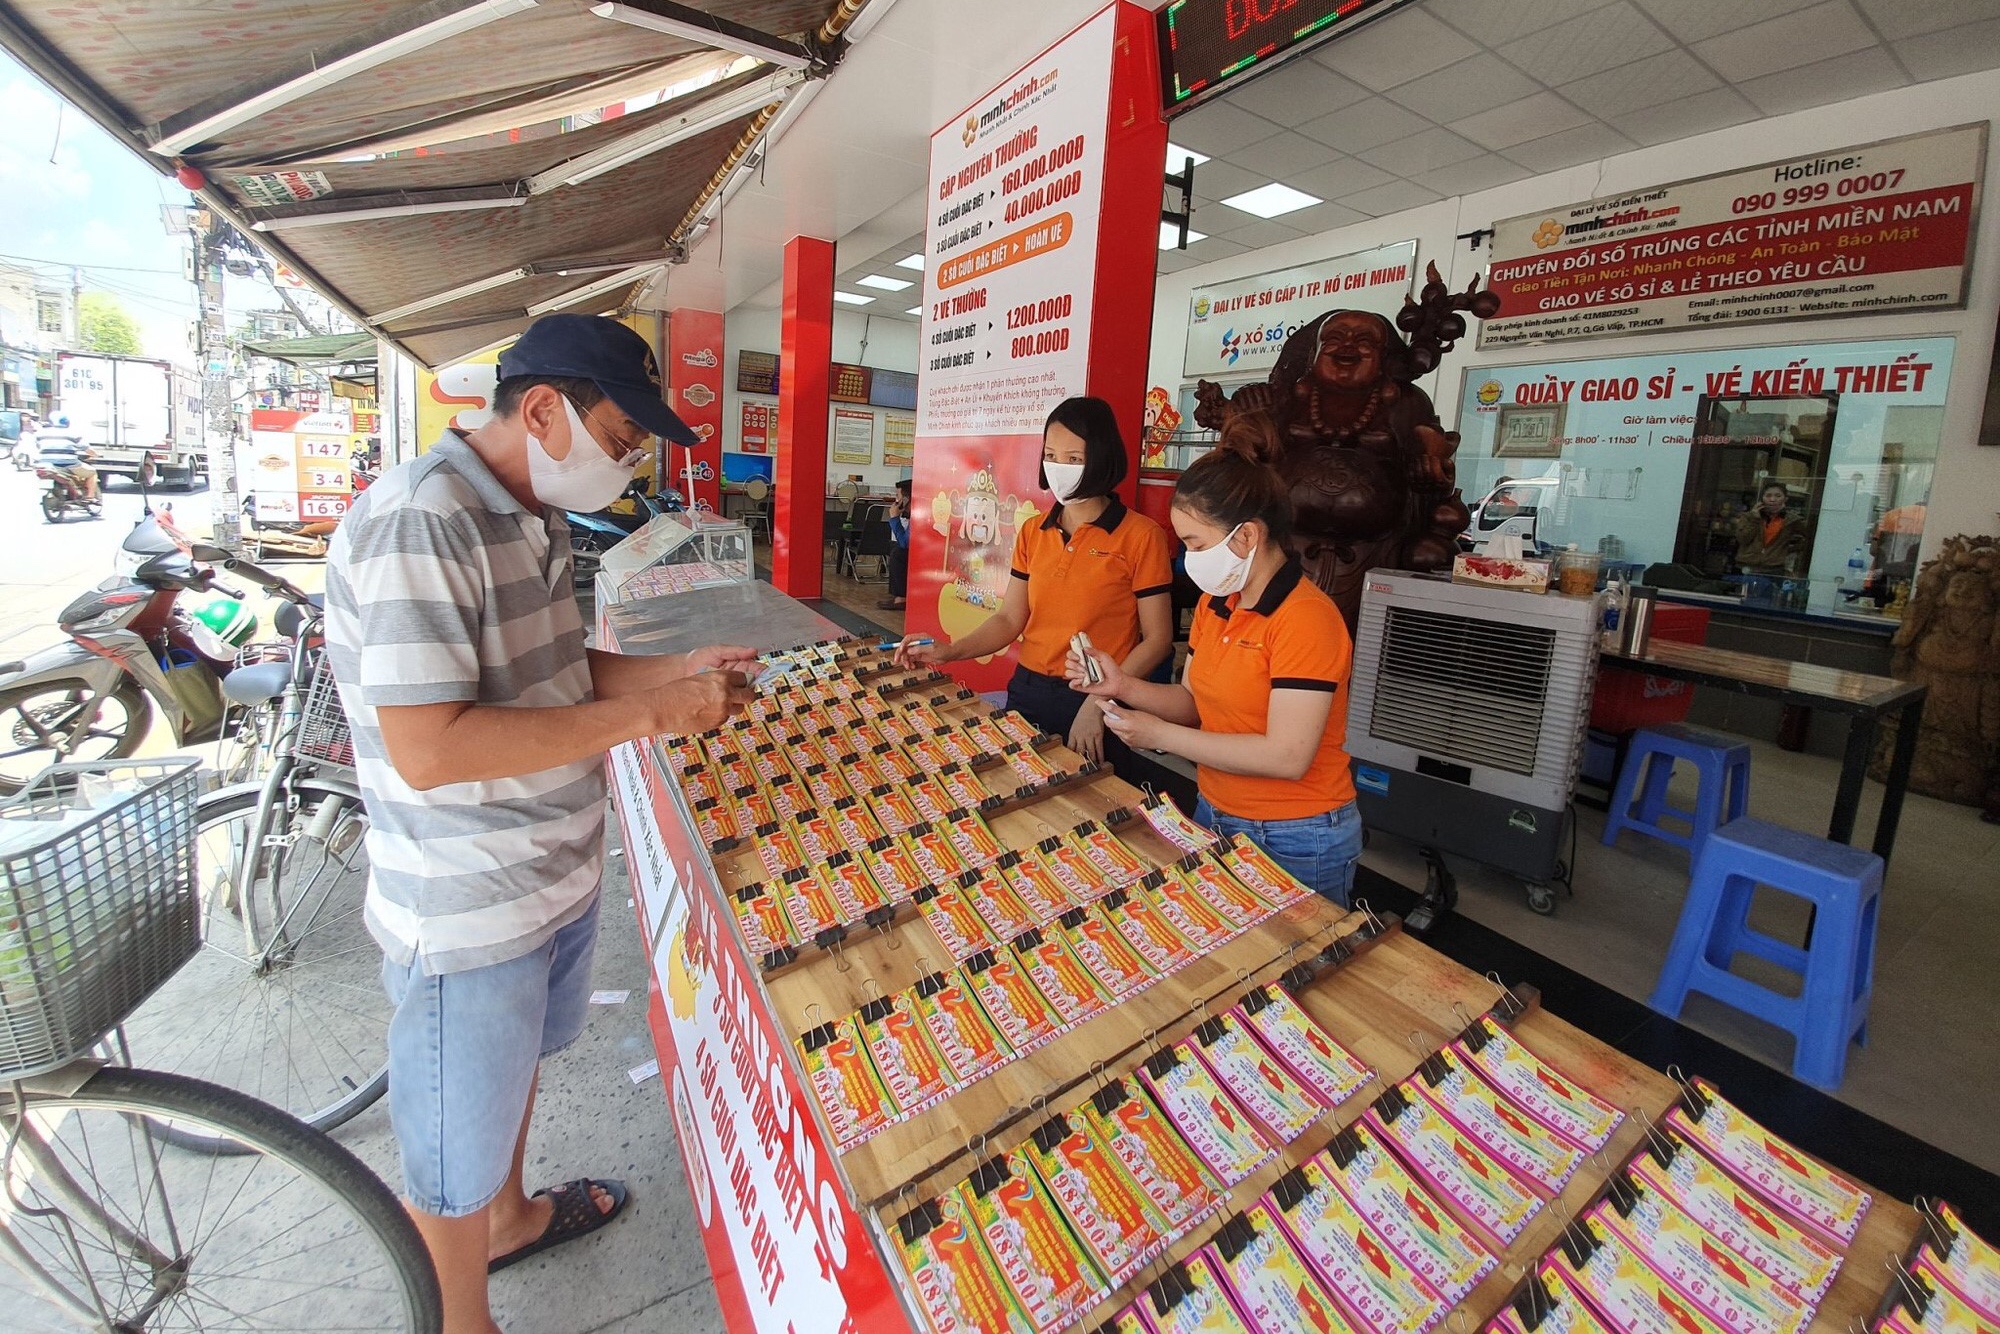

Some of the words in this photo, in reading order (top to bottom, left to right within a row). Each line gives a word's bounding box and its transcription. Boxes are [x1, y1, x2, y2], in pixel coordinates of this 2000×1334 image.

[980, 68, 1058, 128] minhchính.com
[957, 152, 992, 190] NGUYÊN
[1002, 135, 1084, 196] 160.000.000Đ
[1731, 191, 1776, 215] 090
[1783, 182, 1829, 207] 999
[1837, 169, 1906, 198] 0007
[1774, 155, 1862, 183] Hotline:
[1004, 170, 1081, 223] 40.000.000Đ
[1596, 202, 1607, 212] VÉ
[943, 269, 948, 283] 2
[1025, 228, 1048, 252] HOÀN
[1051, 218, 1063, 243] VÉ
[1562, 248, 1596, 271] ĐỔI
[1599, 241, 1627, 265] SỐ
[1631, 232, 1700, 260] TRÚNG
[1706, 225, 1749, 249] CÁC
[1755, 217, 1811, 241] TỈNH
[1817, 204, 1884, 231] MIỀN
[1892, 195, 1961, 221] NAM
[1512, 282, 1540, 294] Giao
[1543, 274, 1570, 289] Tiền
[1574, 271, 1596, 287] Tận
[1600, 268, 1629, 281] Nơi:
[1632, 256, 1682, 276] Nhanh
[1686, 251, 1736, 271] Chóng
[1750, 246, 1774, 260] An
[1780, 239, 1820, 256] Toàn
[1878, 226, 1920, 243] Mật
[1539, 292, 1580, 310] GIAO
[1583, 287, 1605, 304] VÉ
[1638, 277, 1657, 297] SỈ
[1659, 280, 1675, 294] &
[1680, 271, 1703, 292] LẺ
[1707, 268, 1762, 290] THEO
[1769, 261, 1811, 281] YÊU
[1816, 253, 1866, 276] CẦU
[933, 303, 939, 322] 2
[940, 297, 950, 320] VÉ
[1006, 294, 1072, 330] 1.200.000Đ
[1231, 294, 1243, 311] LÝ
[1245, 291, 1257, 309] VÉ
[1259, 286, 1273, 306] SỐ
[1306, 281, 1320, 297] TP.
[1344, 269, 1366, 291] CHÍ
[1369, 265, 1407, 287] MINH
[1688, 297, 1720, 309] Email:
[1721, 282, 1875, 306] minhchinh0007@gmail.com
[1735, 308, 1760, 318] 1900
[1762, 304, 1789, 316] 6131
[1799, 301, 1849, 312] Website:
[1851, 290, 1948, 309] minhchinh.com
[1011, 328, 1070, 359] 800.000Đ
[1266, 321, 1284, 342] SỐ
[1485, 335, 1499, 343] 229
[1628, 317, 1665, 329] TP.HCM
[1504, 320, 1523, 332] phép
[1524, 318, 1541, 328] kinh
[1542, 315, 1567, 325] doanh
[89, 381, 104, 391] 95
[1516, 373, 1576, 406] QUẦY
[1580, 376, 1639, 402] GIAO
[1646, 367, 1677, 400] SỈ
[1705, 365, 1742, 398] VÉ
[1750, 357, 1826, 396] KIẾN
[1833, 352, 1933, 393] THIẾT
[1622, 415, 1644, 425] Giờ
[1646, 415, 1667, 424] làm
[307, 443, 342, 456] 147
[315, 474, 344, 486] 3.4
[307, 502, 345, 514] 16.9
[686, 860, 695, 907] 2
[1194, 883, 1245, 925] 084107
[1118, 920, 1165, 970] 555005
[1157, 903, 1204, 947] 184106
[1030, 966, 1074, 1023] 984905
[1077, 943, 1121, 998] 484105
[979, 987, 1020, 1042] 984904
[695, 1037, 708, 1070] 4
[928, 1015, 967, 1072] 384104
[1276, 1039, 1335, 1095] 664698
[700, 1053, 722, 1101] SỐ
[871, 1042, 911, 1102] 584103
[709, 1085, 738, 1166] CUỐI
[812, 1070, 849, 1135] 984903
[1227, 1073, 1287, 1132] 833598
[1511, 1084, 1590, 1143] 664697
[1177, 1110, 1231, 1174] 095098
[1110, 1135, 1178, 1214] 584102
[1740, 1159, 1838, 1229] 761078
[1051, 1171, 1118, 1257] 984902
[751, 1210, 785, 1307] BIỆT
[986, 1222, 1047, 1317] 084901
[1370, 1208, 1449, 1290] 864693
